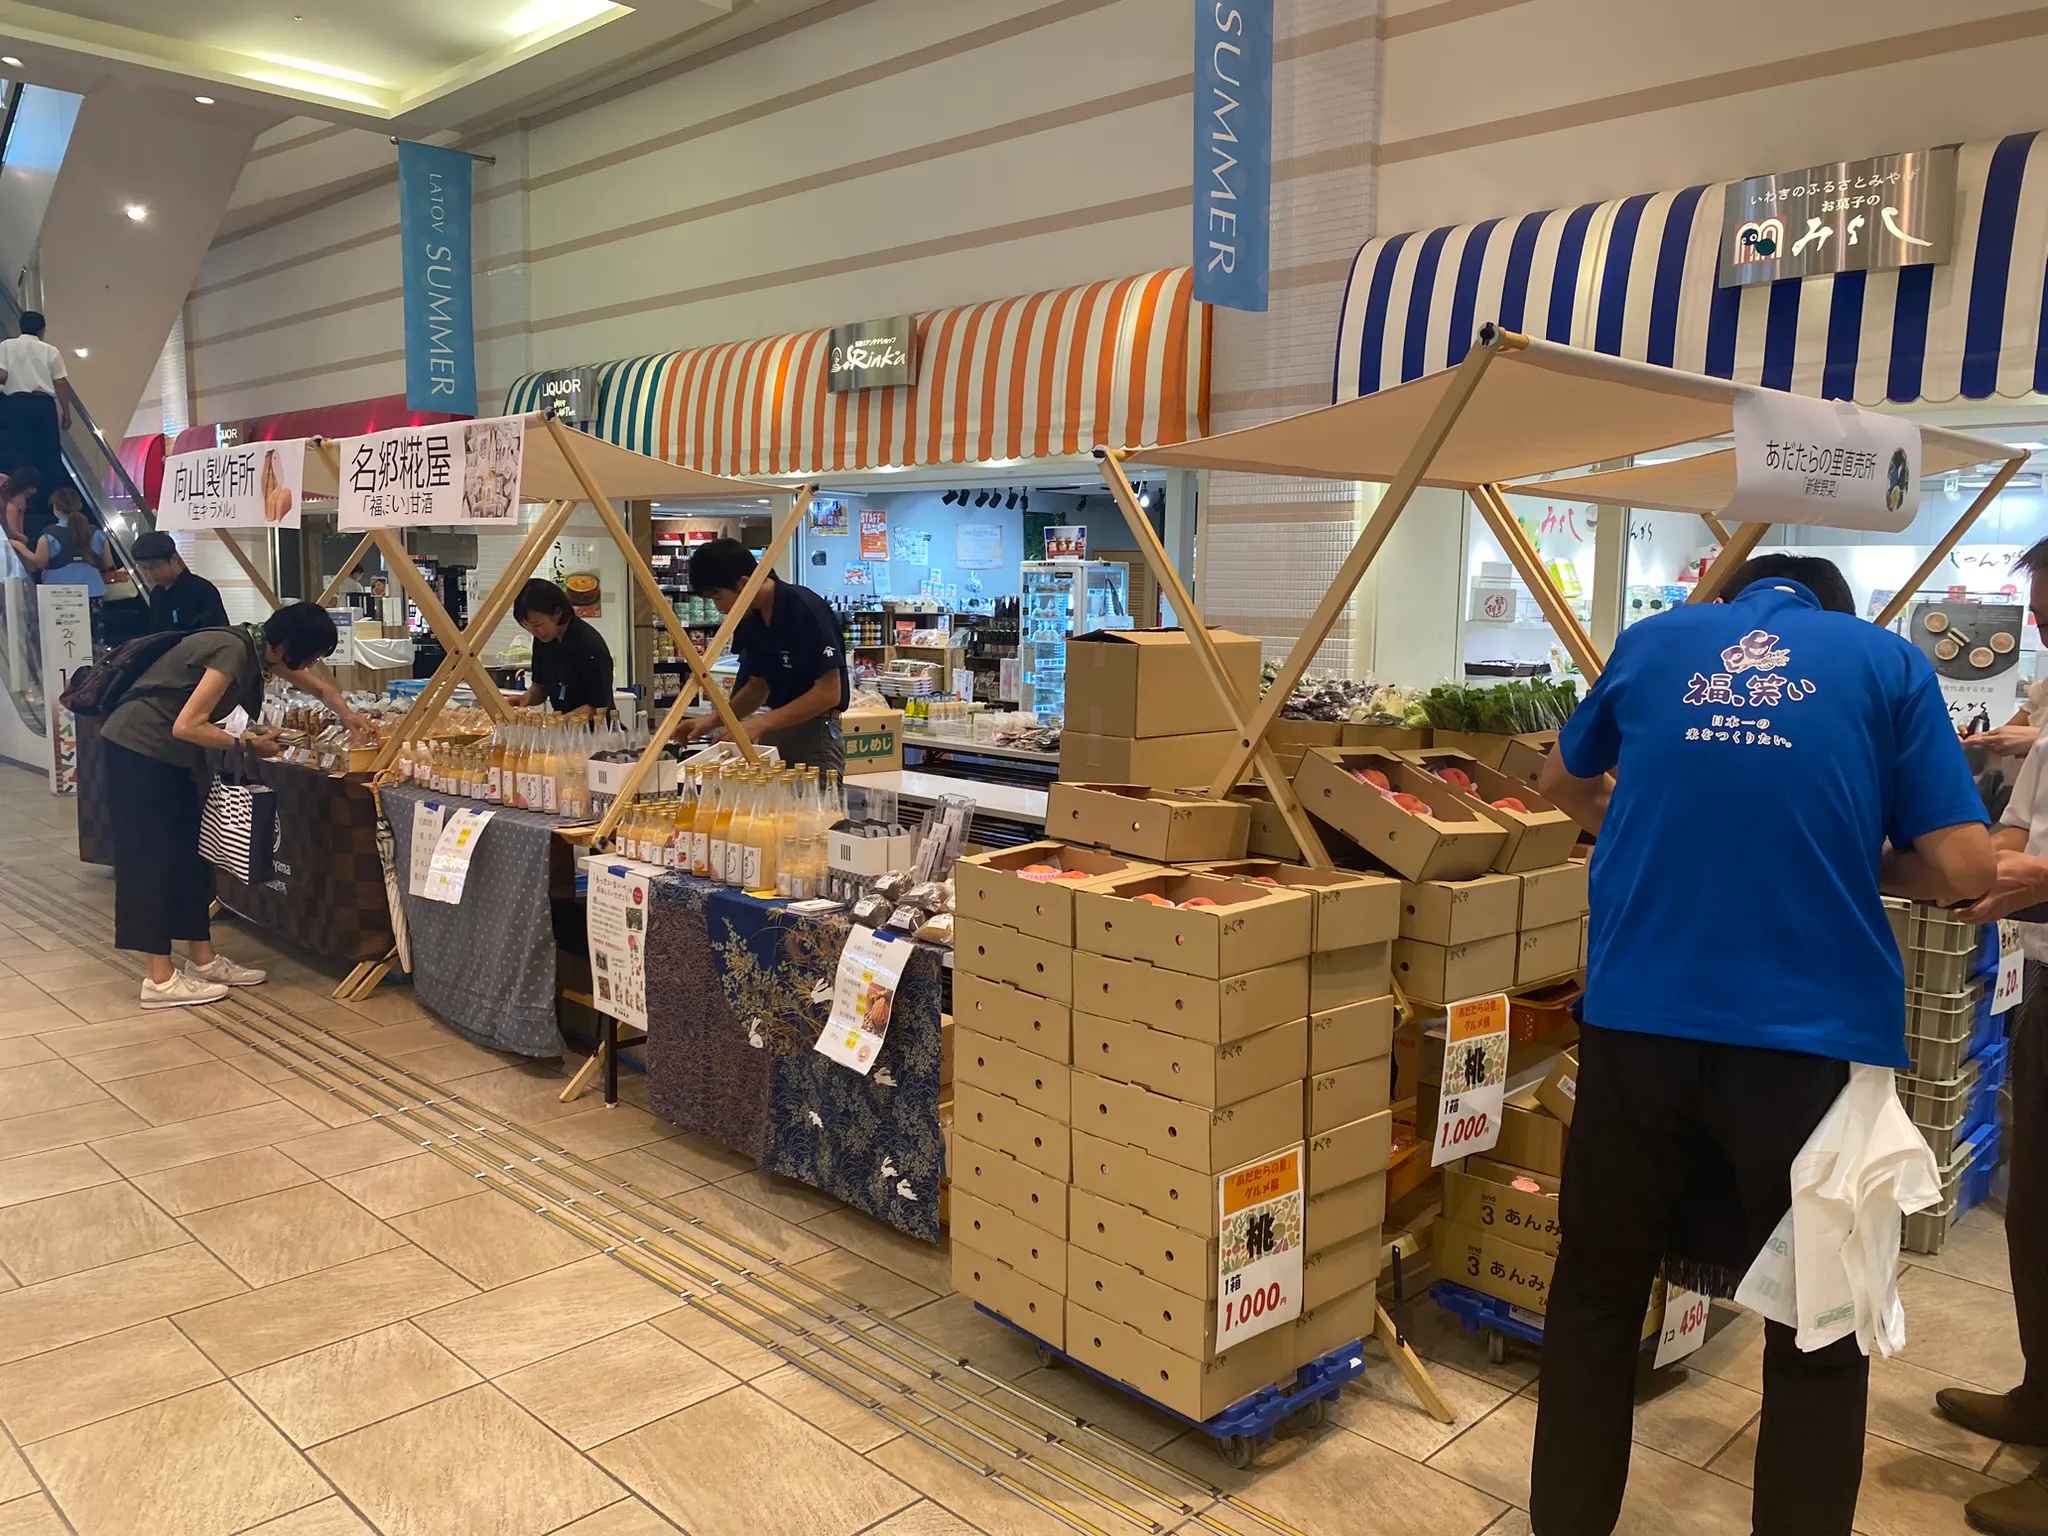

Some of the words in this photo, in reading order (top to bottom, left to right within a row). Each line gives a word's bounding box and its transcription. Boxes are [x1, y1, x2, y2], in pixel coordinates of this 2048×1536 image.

[1208, 2, 1243, 274] SUMMER
[429, 173, 445, 234] LATOV
[1821, 194, 1881, 213] お菓子の
[426, 244, 456, 396] SUMMER
[542, 378, 581, 397] LIQUOR
[1766, 440, 1878, 481] あだたらの里直売所
[174, 452, 256, 503] 向山製作所
[861, 512, 881, 524] STAFF
[1683, 672, 1816, 706] 福、笑い
[1712, 714, 1770, 730] 日本一の
[844, 737, 893, 754] 部しめじ
[1685, 727, 1792, 748] 米をつくりたい。
[1464, 1046, 1486, 1086] 桃
[1444, 1098, 1460, 1115] 1箱
[1230, 1159, 1293, 1185] 「あだたらの里」
[1246, 1212, 1275, 1259] 桃
[1224, 1274, 1242, 1296] 1箱
